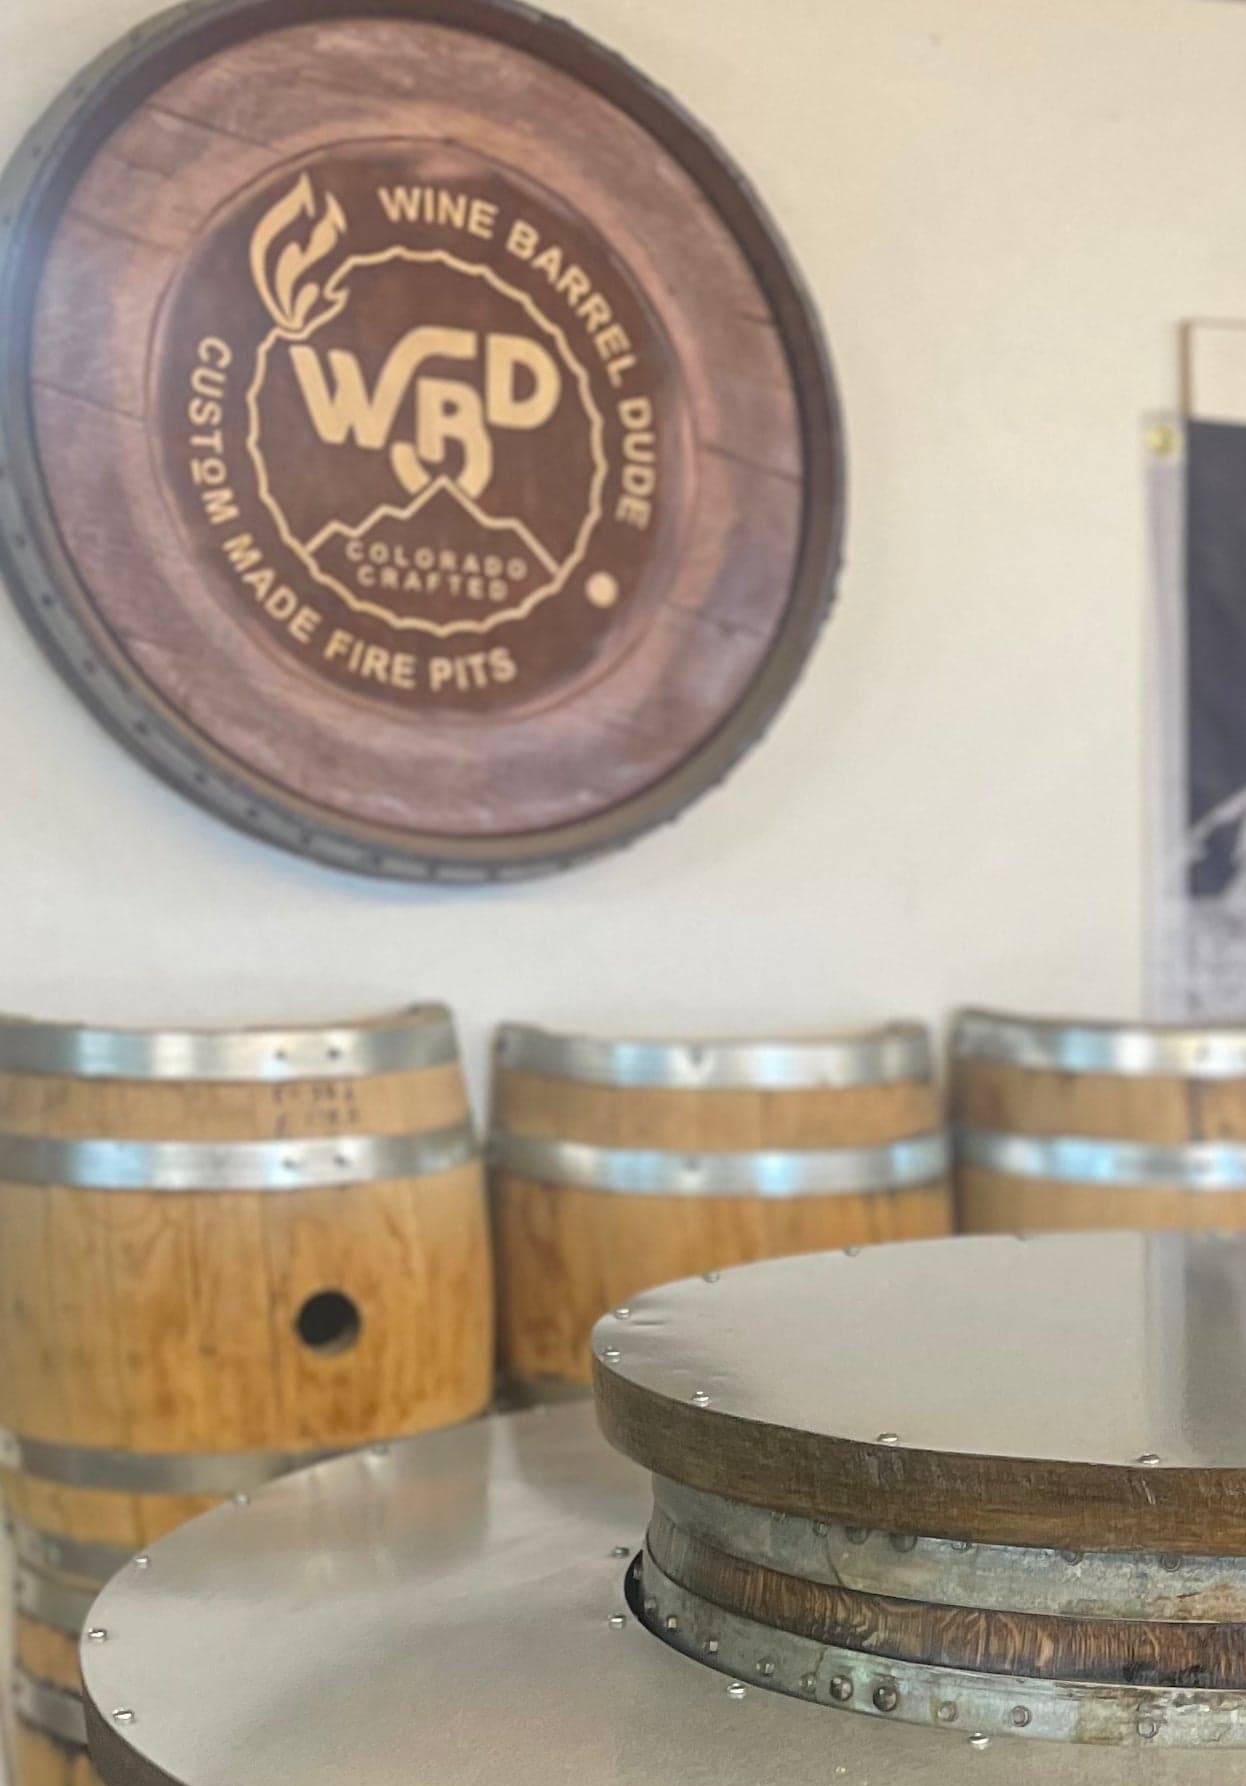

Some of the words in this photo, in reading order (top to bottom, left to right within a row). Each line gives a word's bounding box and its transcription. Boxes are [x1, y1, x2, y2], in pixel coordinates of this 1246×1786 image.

[378, 186, 497, 238] WINE
[505, 221, 635, 387] BARREL
[617, 397, 655, 528] DUDE
[345, 539, 527, 581] COLORADO
[357, 564, 508, 602] CRAFTED
[223, 533, 320, 642] MADE
[324, 629, 416, 689] FIRE
[429, 647, 517, 689] PITS
